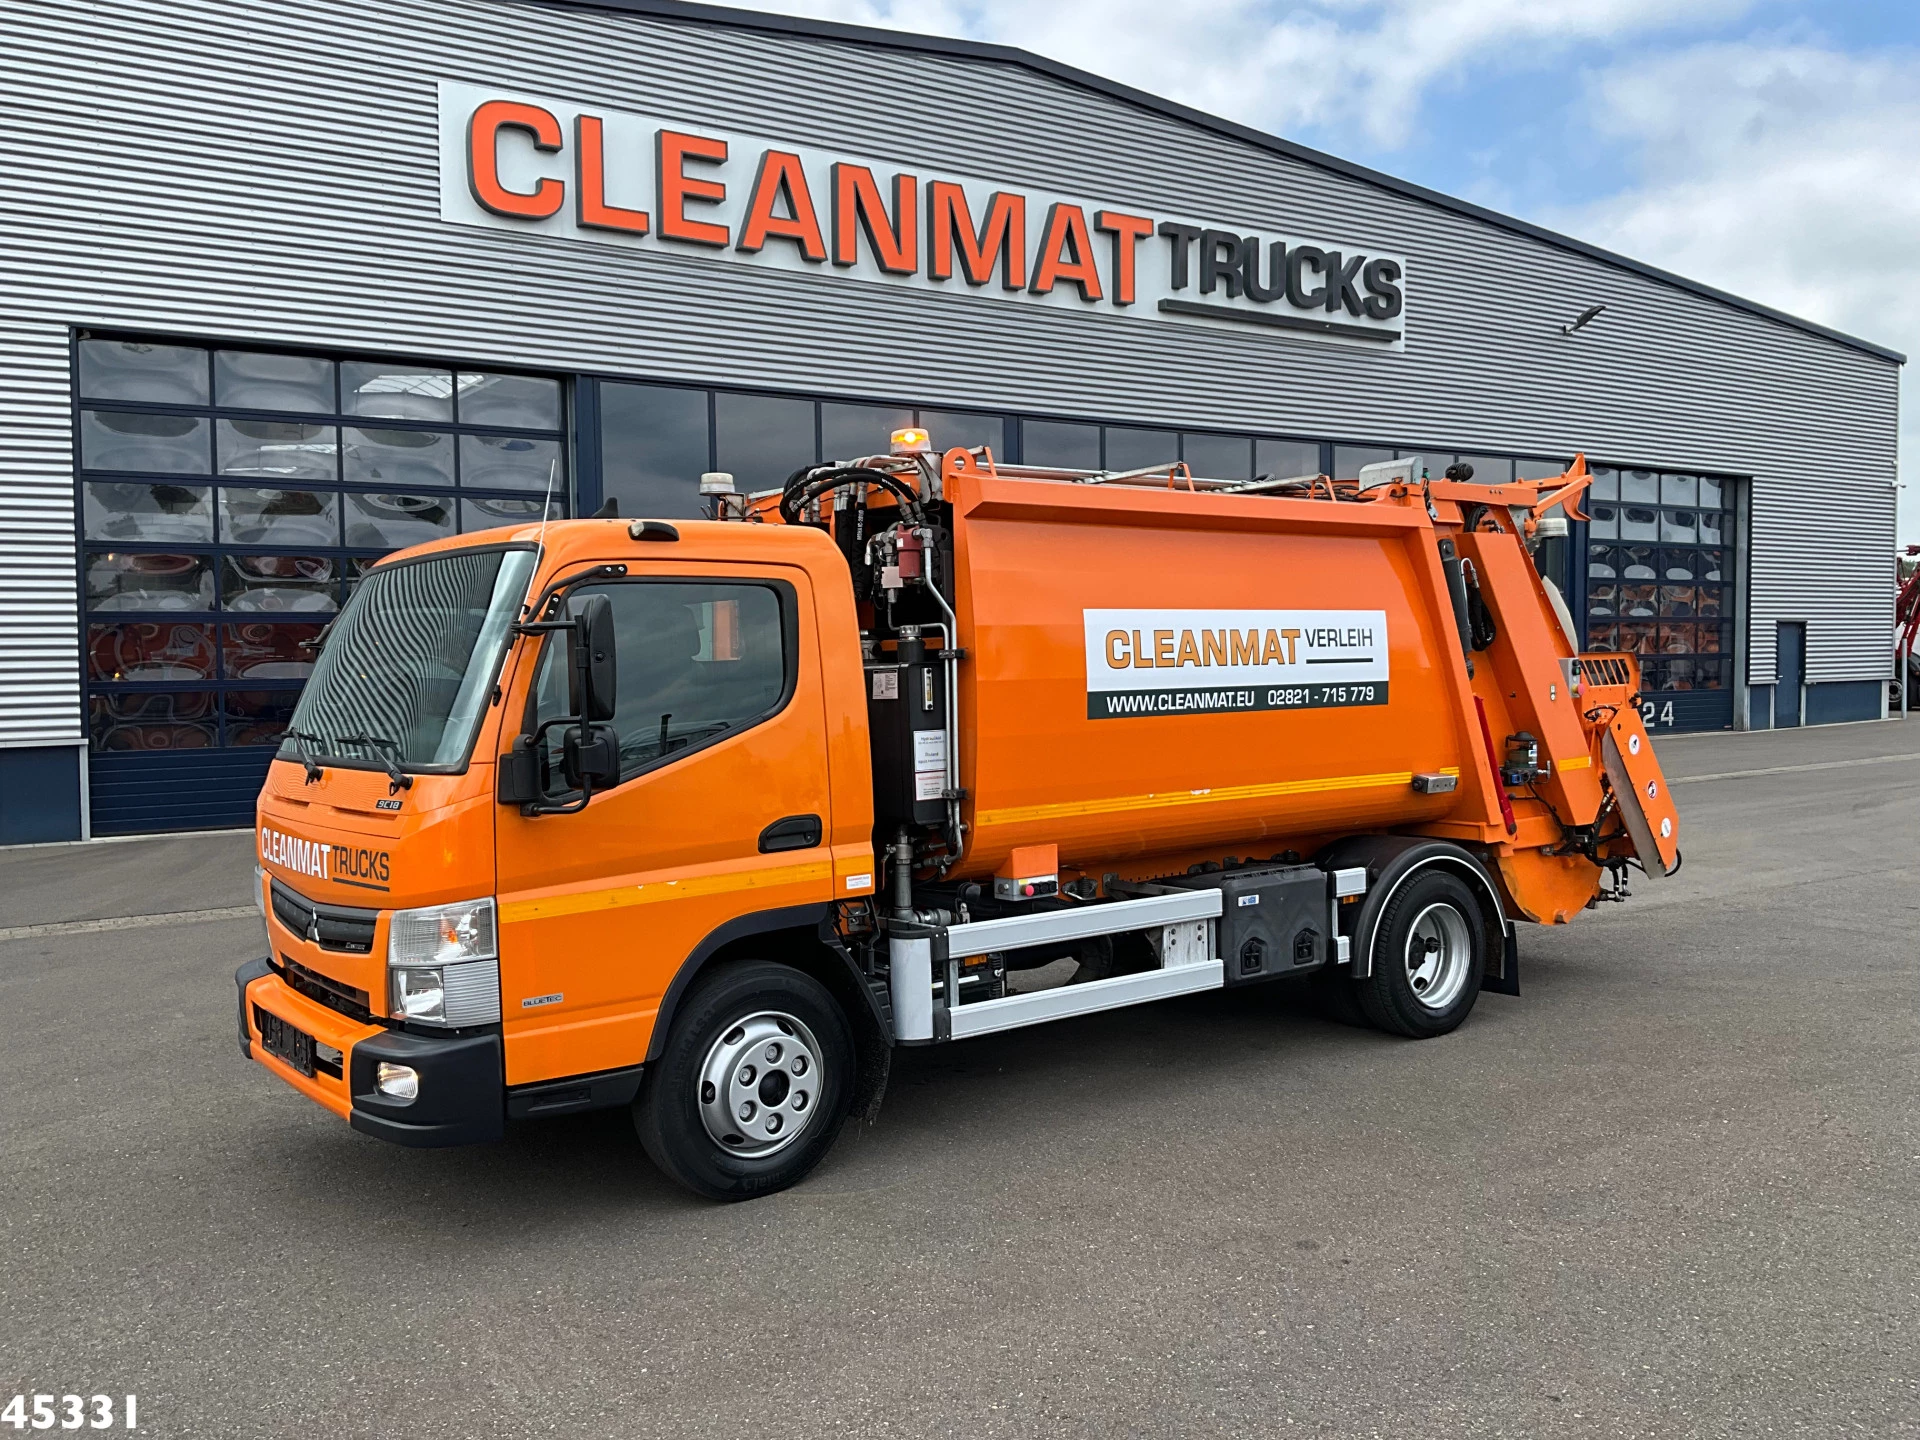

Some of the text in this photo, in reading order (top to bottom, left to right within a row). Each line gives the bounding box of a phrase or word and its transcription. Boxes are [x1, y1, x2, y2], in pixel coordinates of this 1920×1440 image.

[466, 99, 1402, 320] CLEANMAT TRUCKS
[1105, 628, 1373, 669] CLEANMAT VERLEIH
[1106, 690, 1255, 713] WWW.CLEANMAT.EU
[1267, 688, 1310, 705] 02821
[1321, 686, 1347, 703] 715
[1350, 685, 1374, 702] 779
[1642, 701, 1674, 728] 24
[377, 800, 400, 810] 9C18
[261, 827, 390, 882] CLEANMAT TRUCKS
